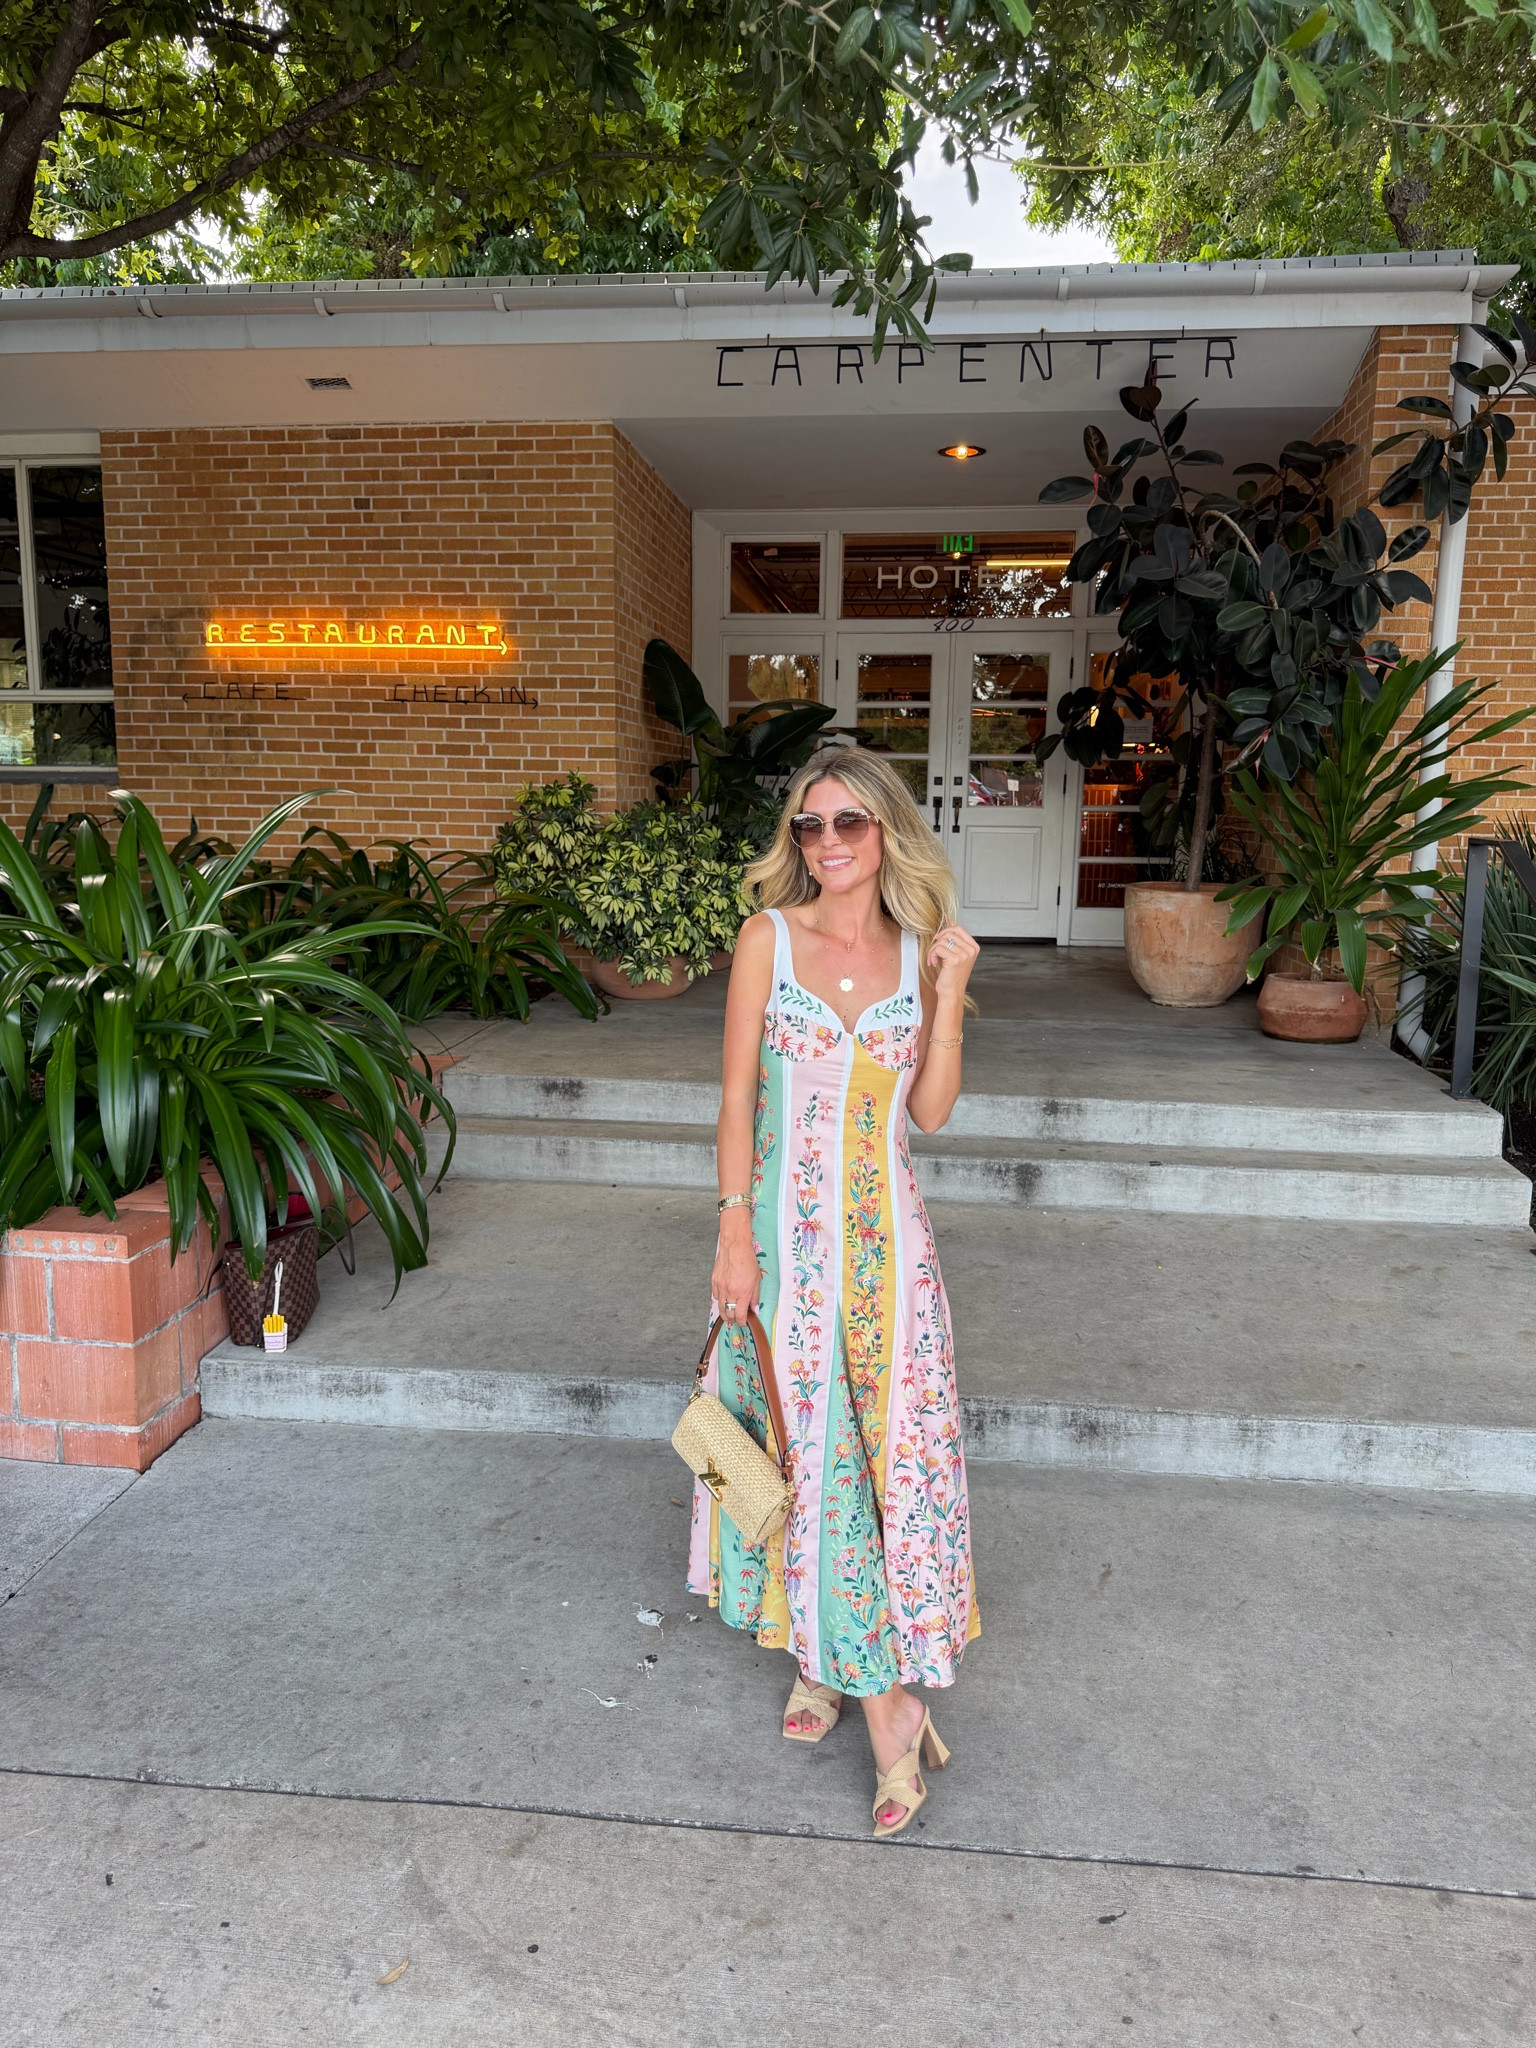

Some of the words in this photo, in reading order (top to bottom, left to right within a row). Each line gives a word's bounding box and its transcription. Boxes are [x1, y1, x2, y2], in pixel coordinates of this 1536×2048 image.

[716, 338, 1236, 386] CARPENTER
[205, 623, 498, 646] RESTAURANT
[933, 618, 975, 632] 400
[203, 681, 290, 700] CAFE
